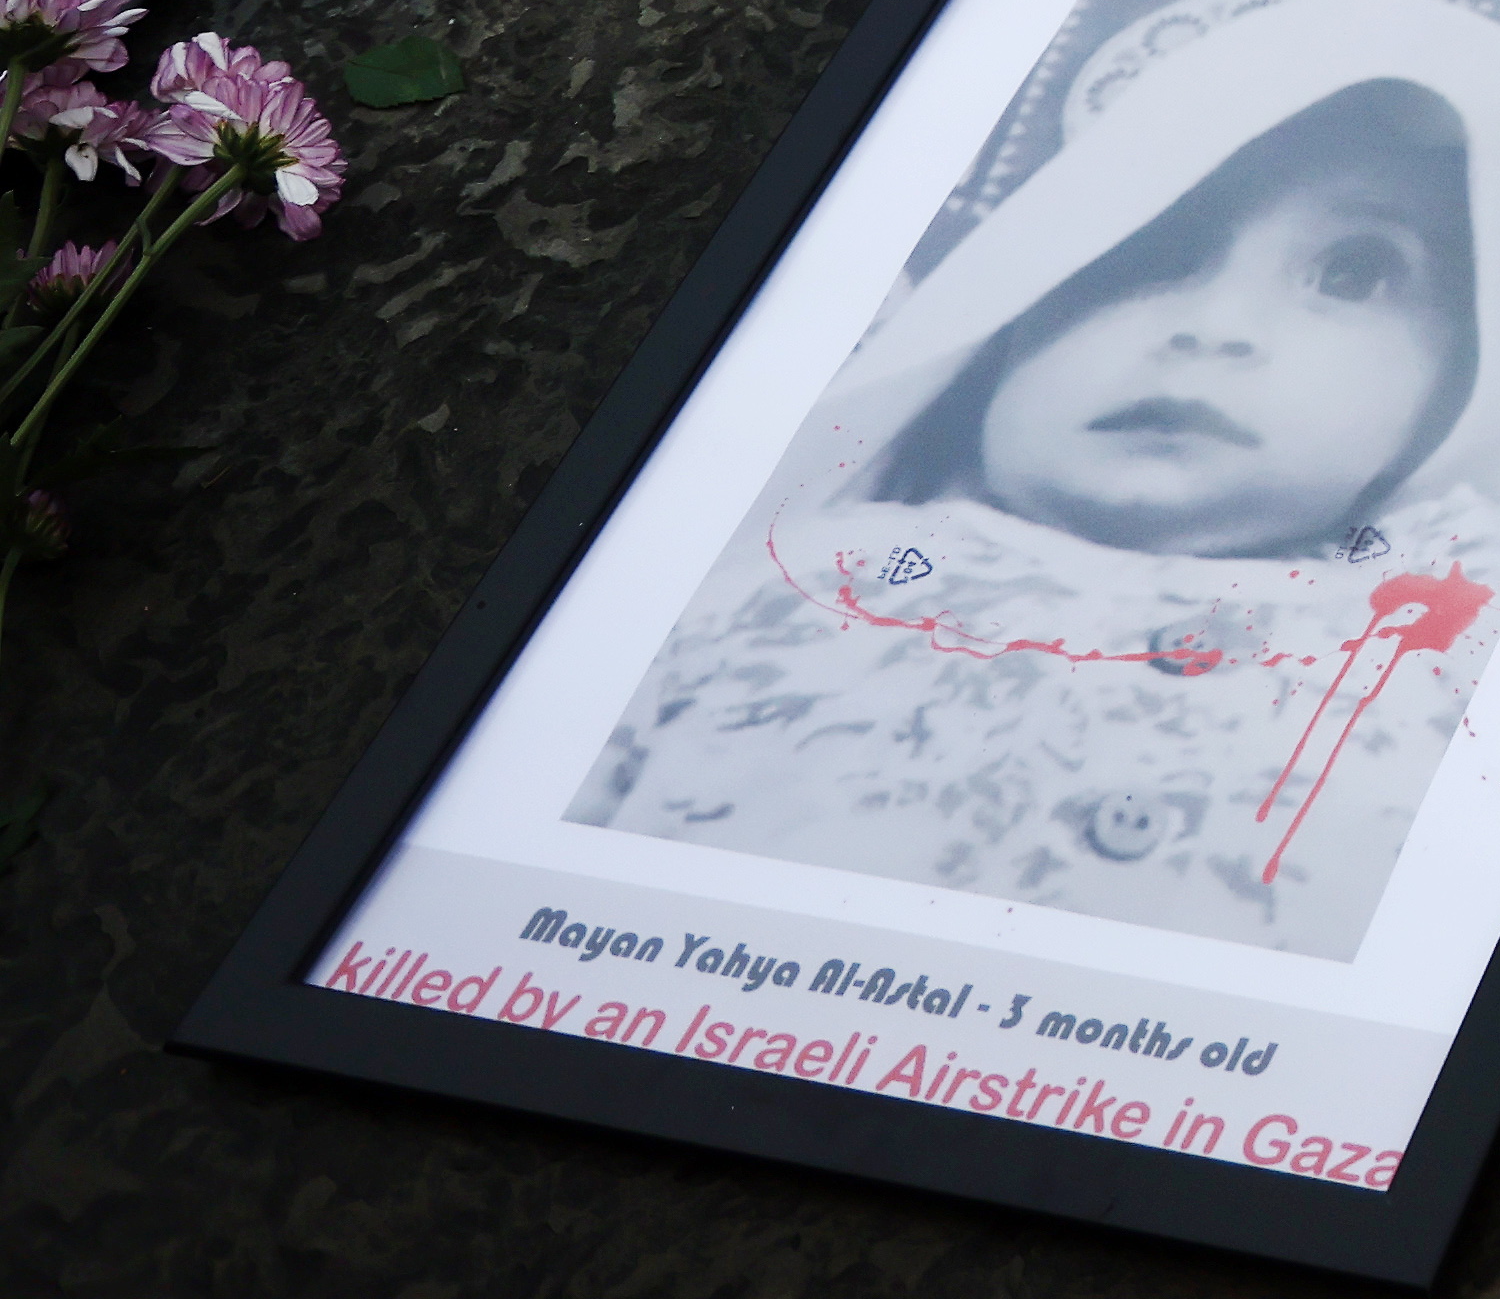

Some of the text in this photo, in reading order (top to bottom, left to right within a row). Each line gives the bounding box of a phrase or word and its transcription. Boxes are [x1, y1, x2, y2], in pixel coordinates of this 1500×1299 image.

[328, 944, 1404, 1187] killed by an Israeli Airstrike in Gaza
[519, 907, 664, 962] Mayan
[675, 933, 800, 992] Yahya
[808, 959, 973, 1018] Al-Astal
[999, 994, 1031, 1029] 3
[1036, 1011, 1193, 1060] months
[1200, 1037, 1278, 1076] old
